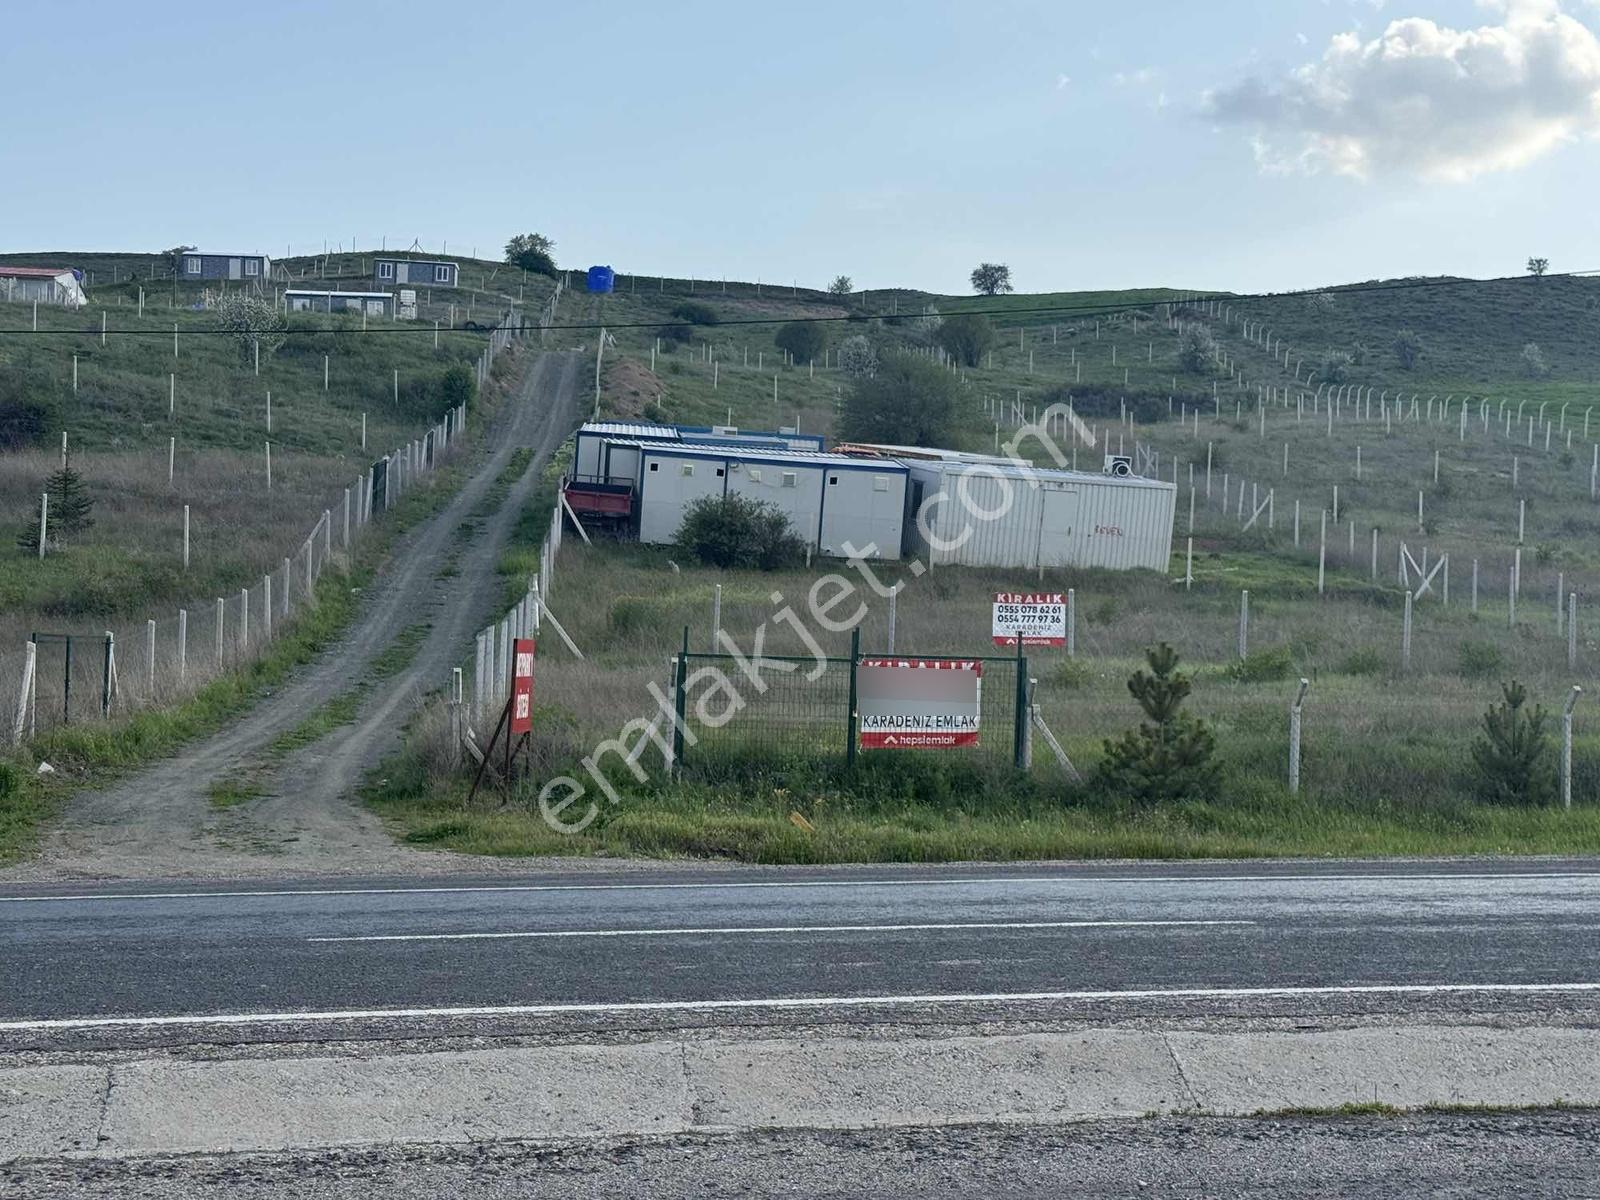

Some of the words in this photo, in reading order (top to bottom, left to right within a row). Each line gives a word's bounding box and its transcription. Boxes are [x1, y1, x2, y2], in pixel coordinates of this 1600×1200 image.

[998, 605, 1019, 613] 0555
[1021, 605, 1038, 613] 078
[997, 615, 1019, 623] 0554
[1021, 615, 1036, 623] 777
[1037, 615, 1048, 623] 97
[1050, 615, 1061, 623] 36
[936, 715, 977, 728] EMLAK
[899, 734, 956, 746] hepsiemlak
